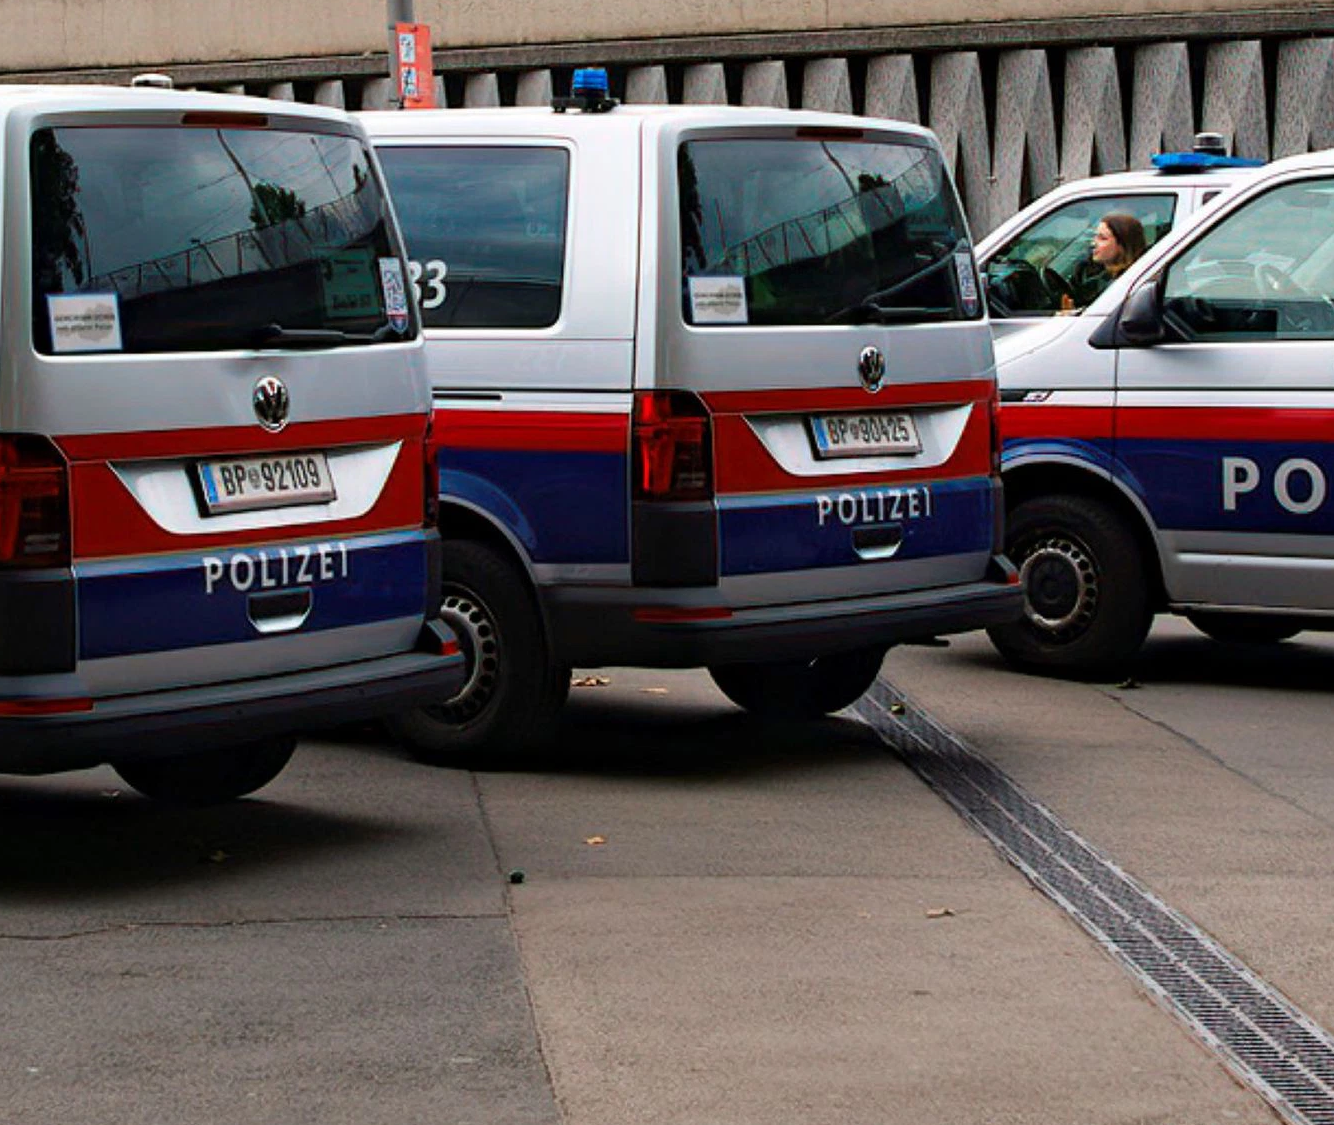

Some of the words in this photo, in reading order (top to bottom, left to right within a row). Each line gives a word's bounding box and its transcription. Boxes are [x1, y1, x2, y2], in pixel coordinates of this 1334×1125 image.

[220, 464, 247, 496] BP
[260, 457, 322, 493] 92109
[816, 486, 931, 526] POLIZEI
[203, 542, 348, 594] POLIZEI
